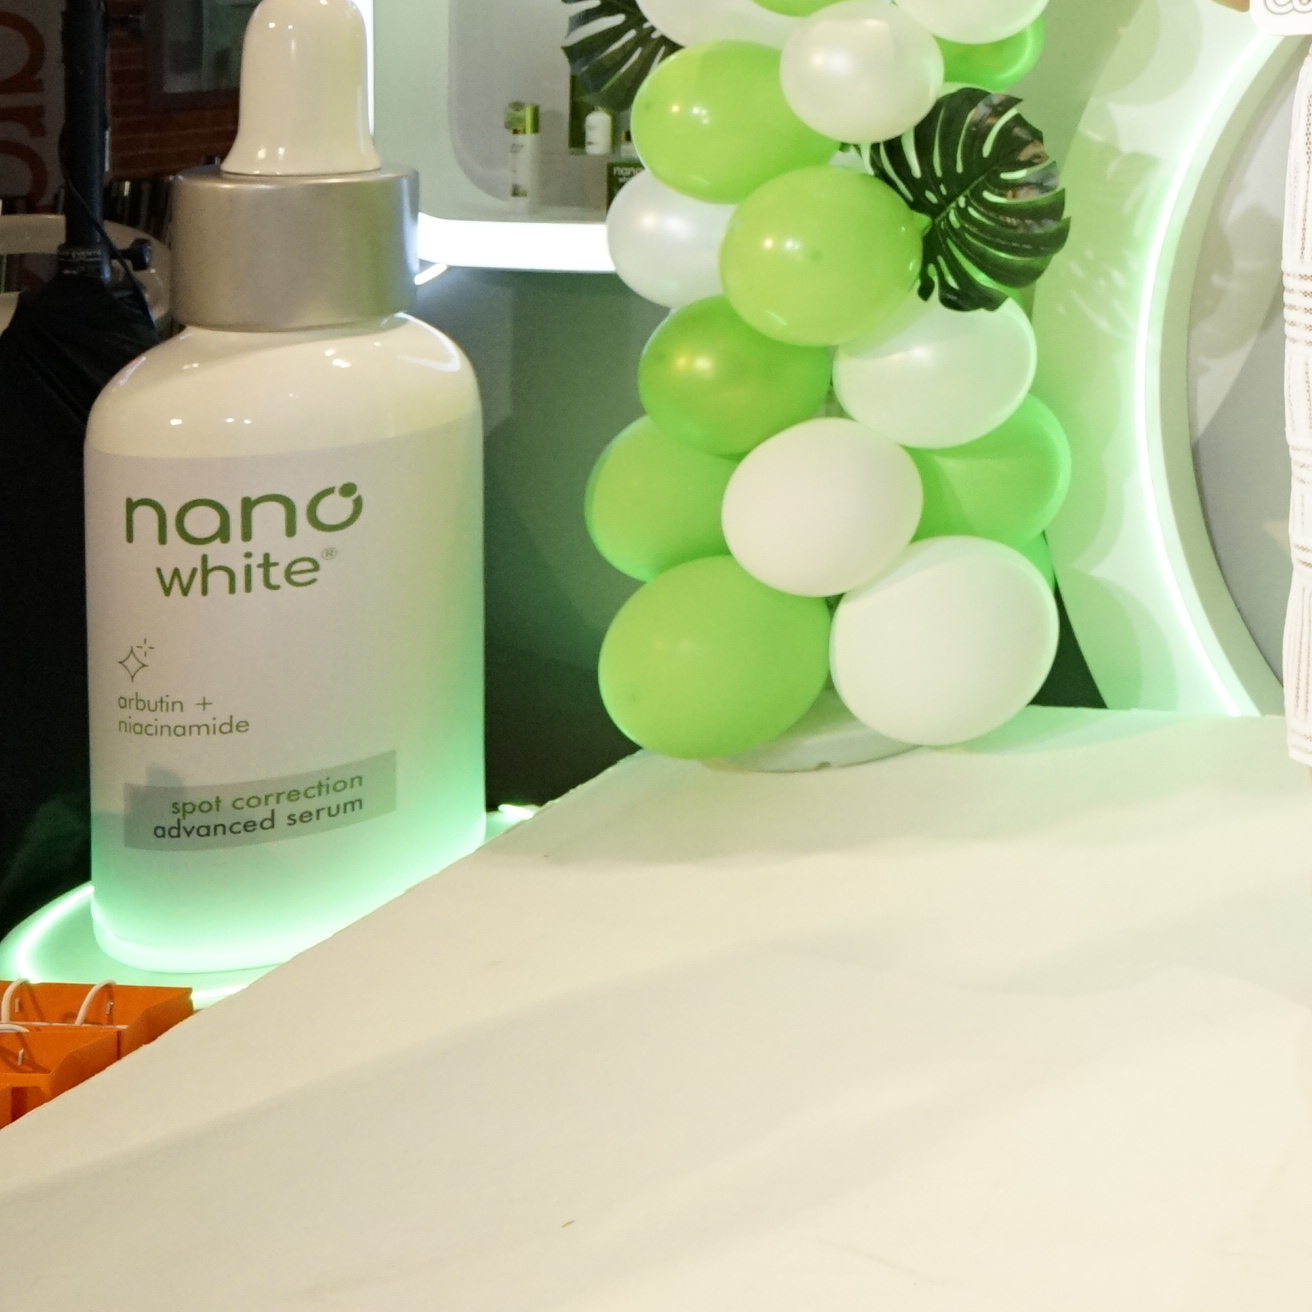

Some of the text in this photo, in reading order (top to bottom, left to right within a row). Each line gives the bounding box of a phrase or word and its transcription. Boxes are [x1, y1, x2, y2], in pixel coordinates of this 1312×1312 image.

[125, 481, 363, 545] nano
[118, 692, 184, 713] arbutin
[118, 715, 250, 737] niacinamide
[171, 775, 363, 820] spot correction
[153, 798, 363, 839] advanced serum
